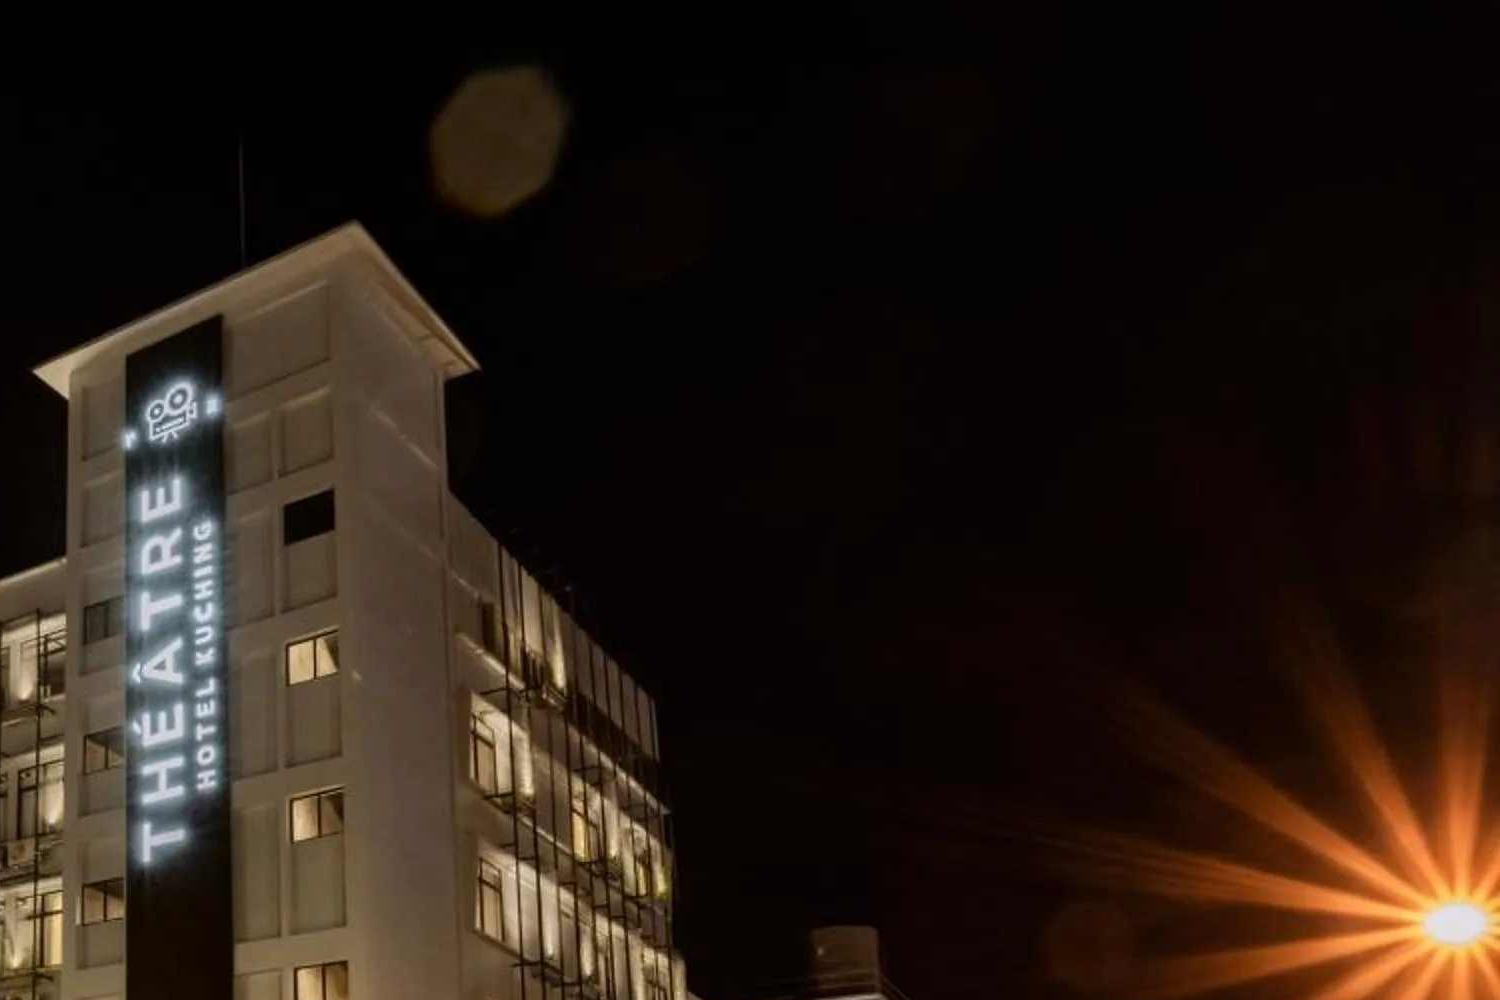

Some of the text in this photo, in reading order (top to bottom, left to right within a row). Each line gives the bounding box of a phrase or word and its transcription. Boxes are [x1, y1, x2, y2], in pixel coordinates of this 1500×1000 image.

[132, 477, 186, 864] THÉÂTRE
[193, 519, 217, 790] HOTEL KUCHING
